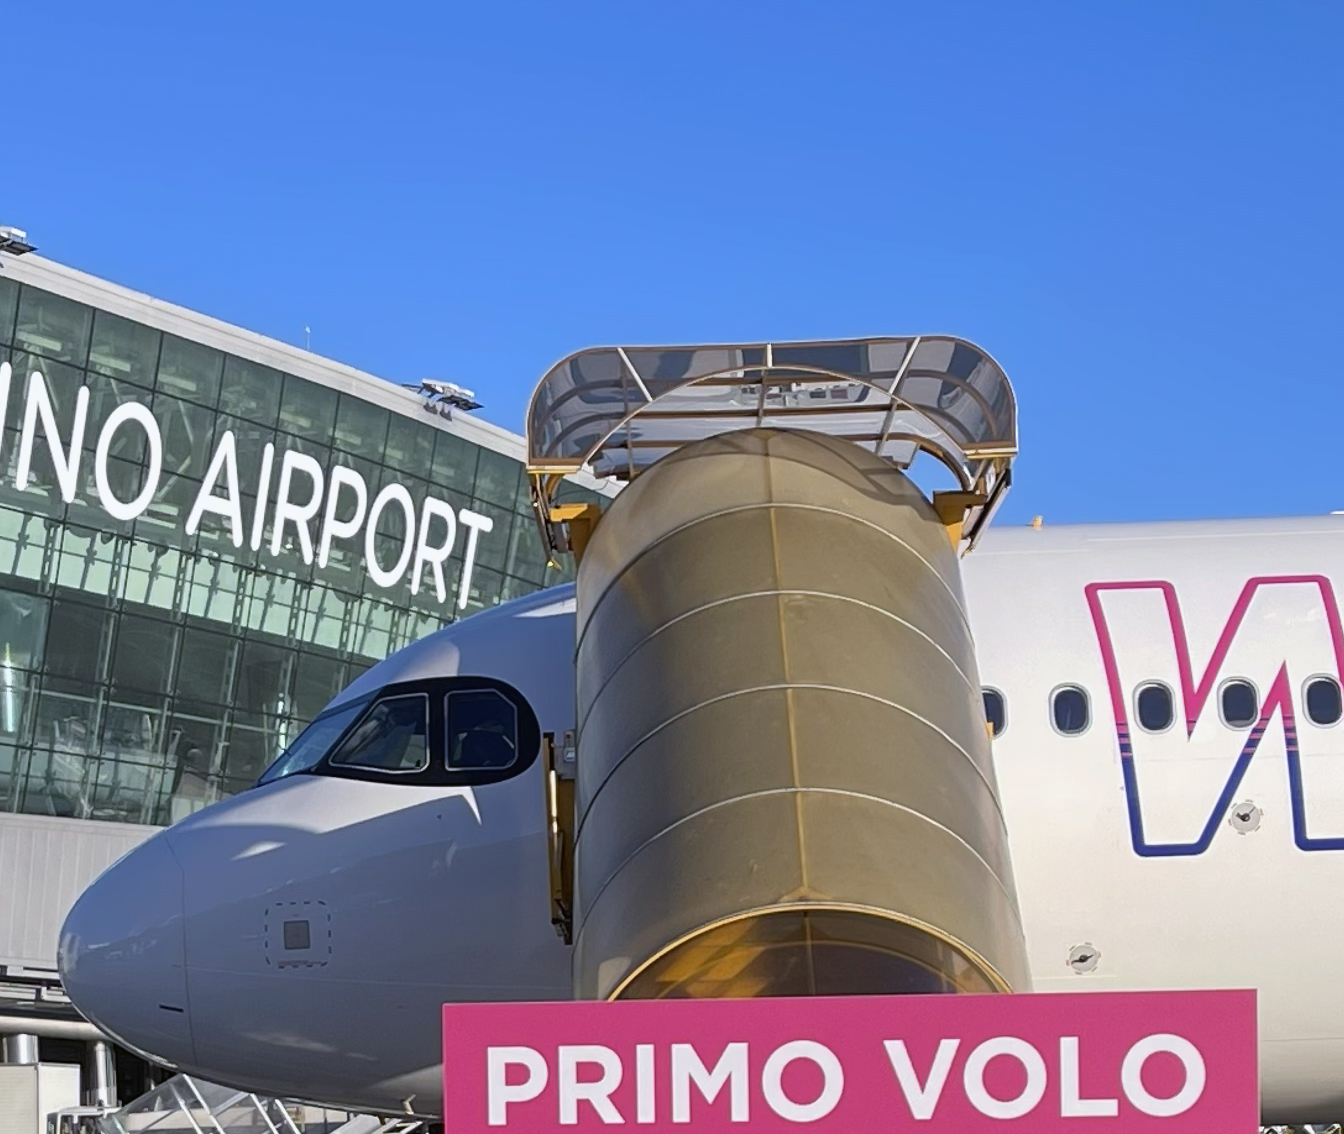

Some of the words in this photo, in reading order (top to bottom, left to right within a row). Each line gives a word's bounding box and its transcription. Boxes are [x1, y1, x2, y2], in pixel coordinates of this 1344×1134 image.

[184, 429, 493, 611] AIRPORT
[487, 1040, 845, 1127] PRIMO
[883, 1033, 1206, 1120] VOLO
